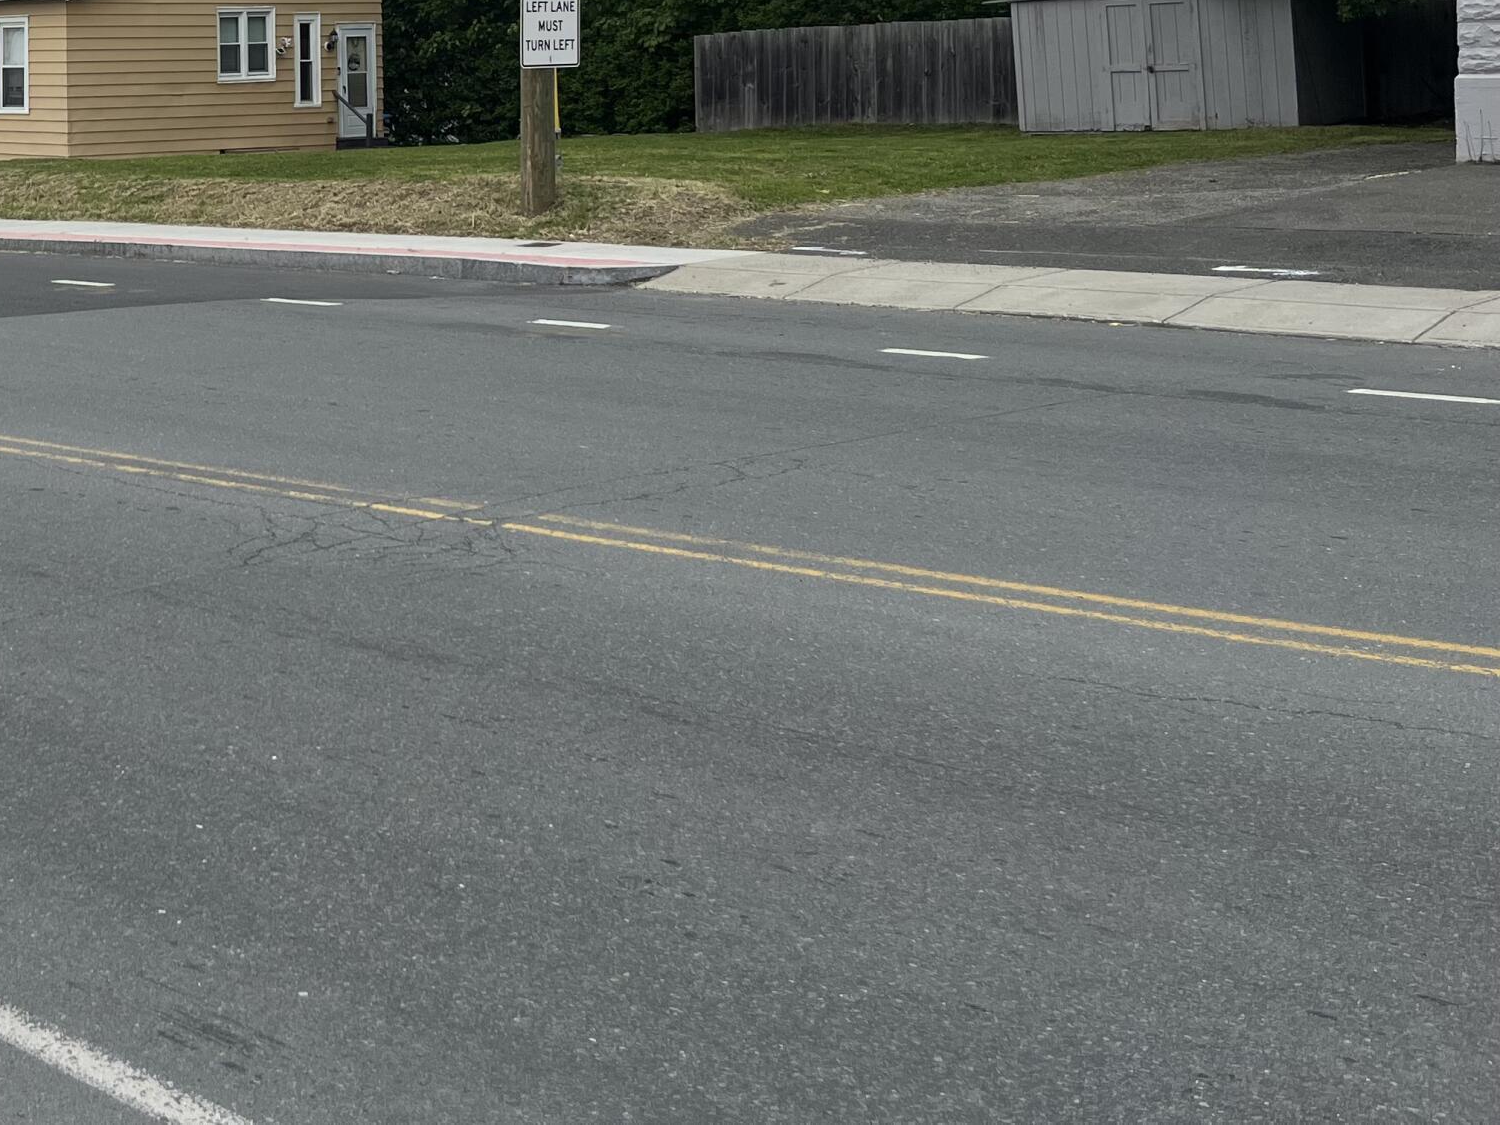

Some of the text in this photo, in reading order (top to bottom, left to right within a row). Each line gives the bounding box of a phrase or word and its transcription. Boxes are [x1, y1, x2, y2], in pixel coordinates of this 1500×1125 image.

[526, 1, 575, 13] LEFT LANE
[538, 20, 563, 32] MUST
[525, 39, 575, 51] TURN LEFT
